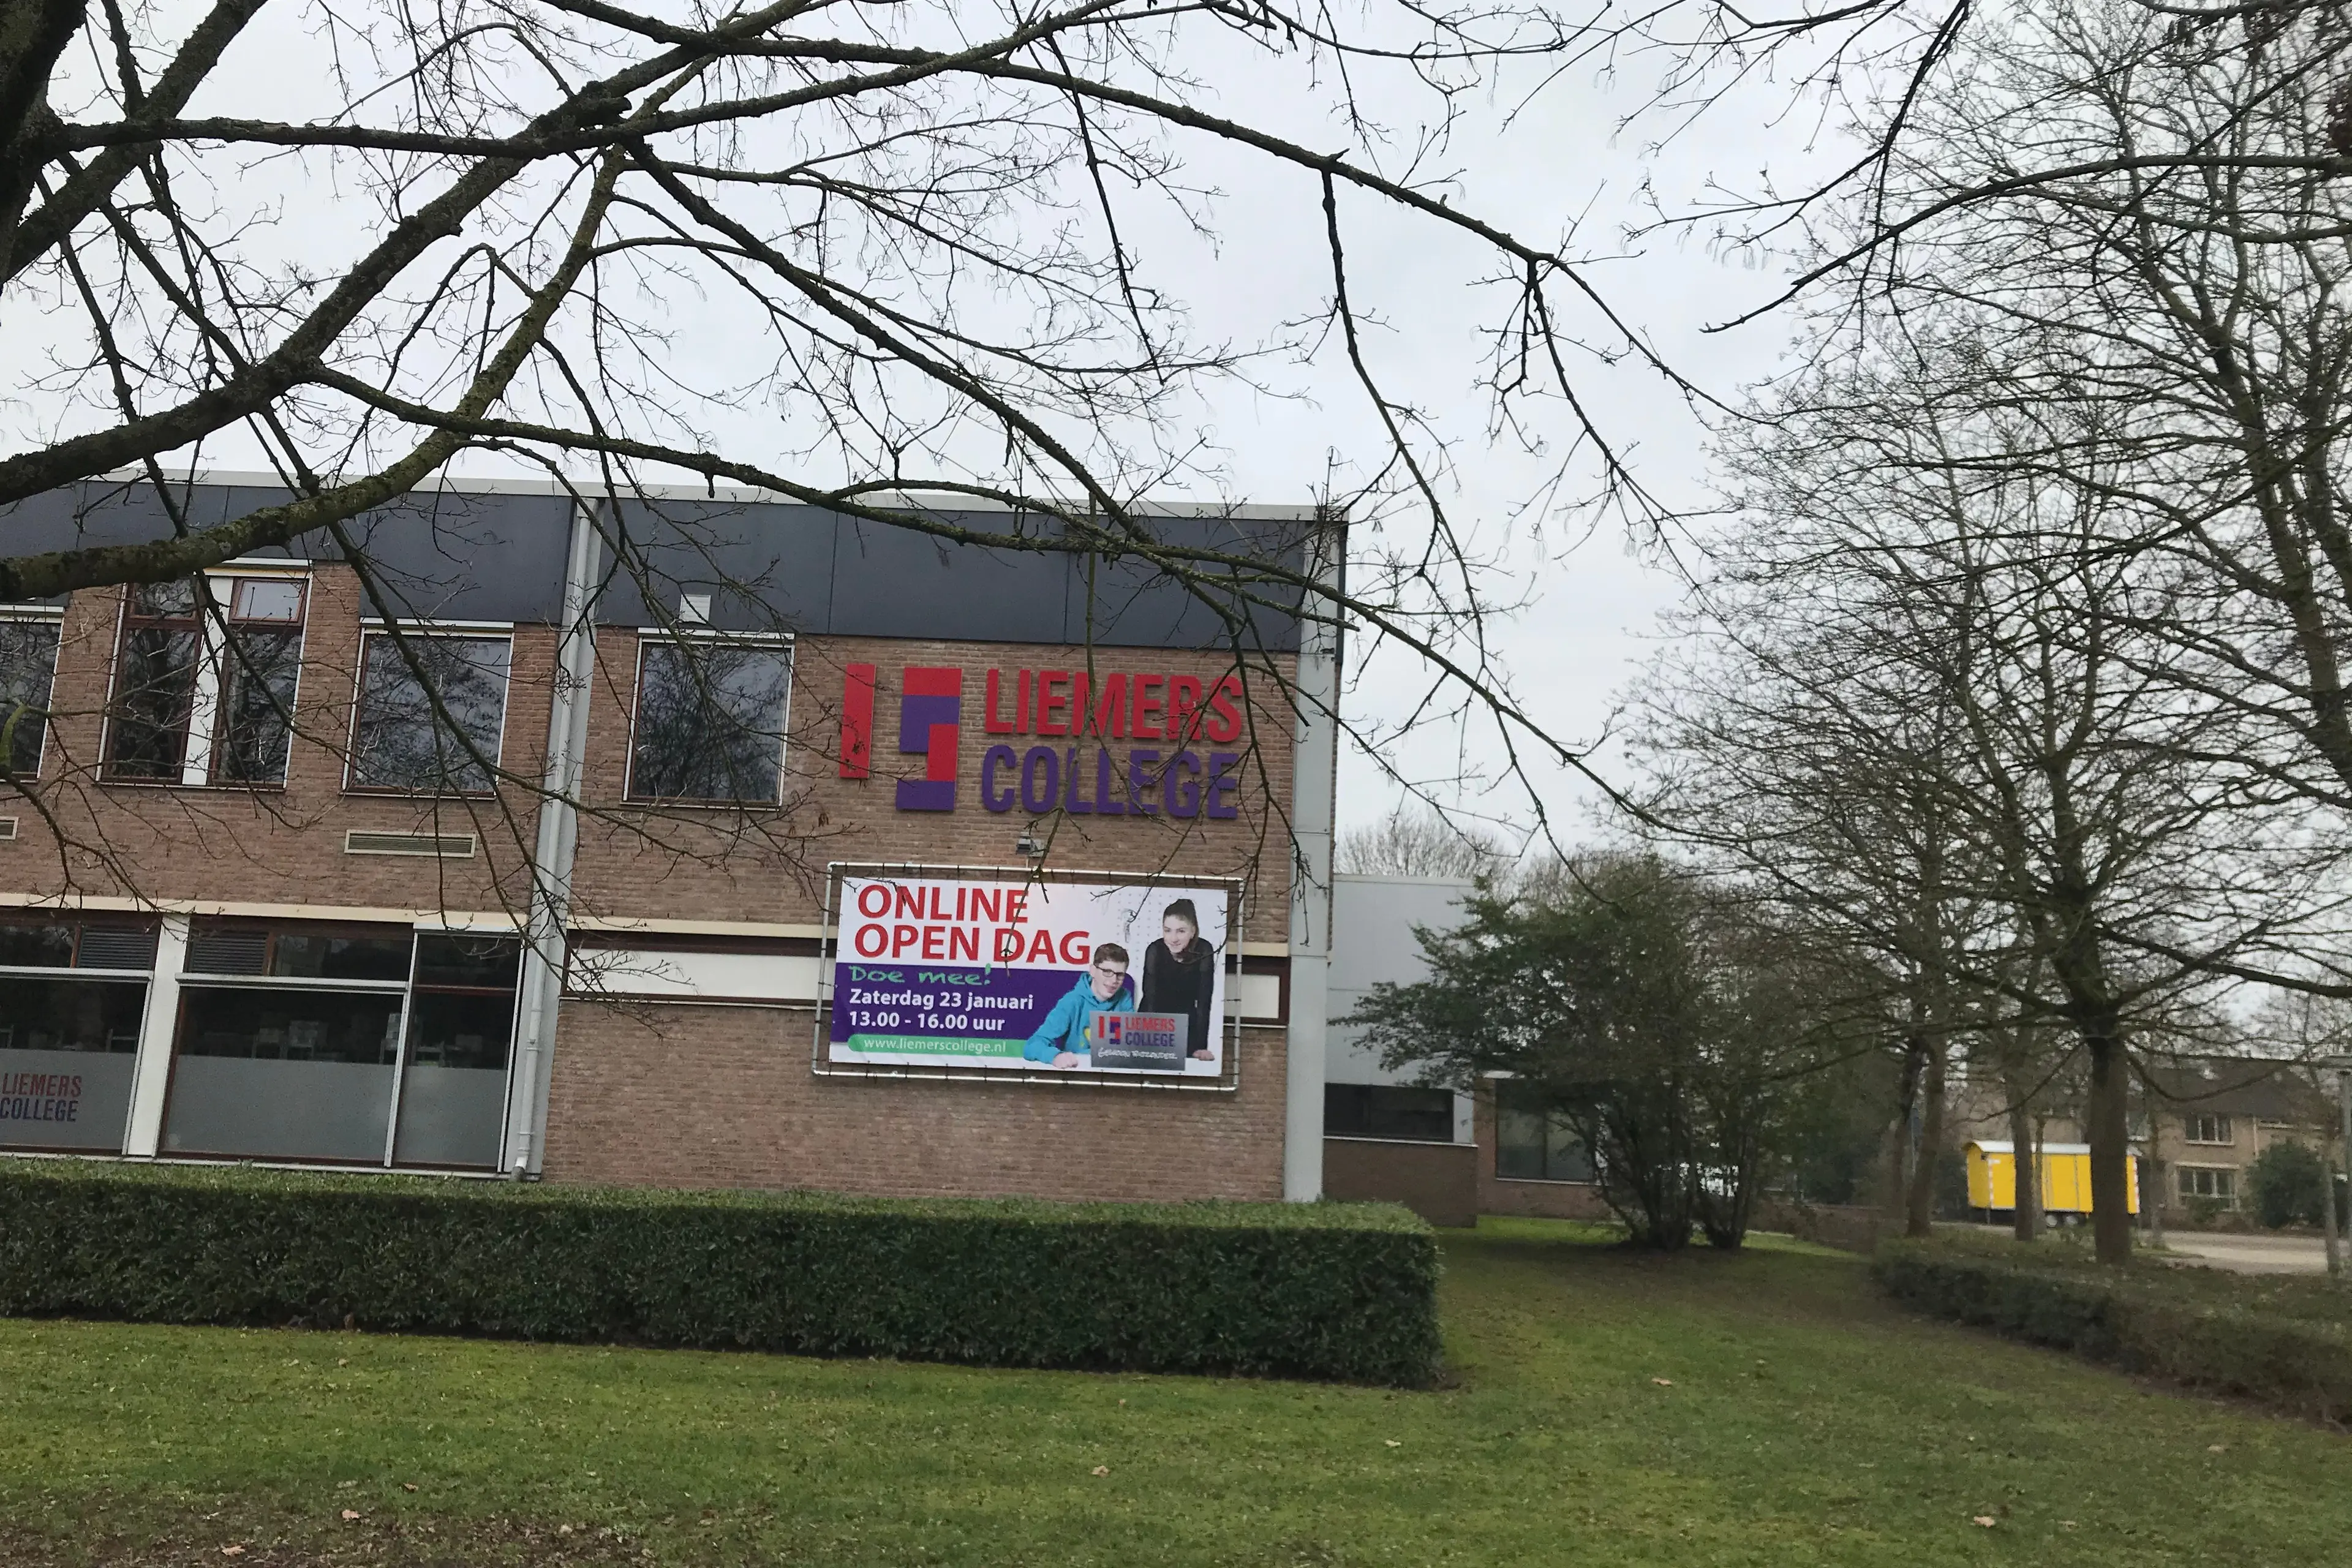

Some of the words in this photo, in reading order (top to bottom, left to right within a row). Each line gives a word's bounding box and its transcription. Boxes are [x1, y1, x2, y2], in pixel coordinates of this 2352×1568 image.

[984, 669, 1243, 742] LIEMERS
[982, 745, 1240, 820] COLLEGE
[858, 884, 1029, 923] ONLINE
[854, 923, 980, 961] OPEN
[993, 928, 1090, 965] DAG
[848, 965, 905, 983] Doe
[919, 963, 992, 985] mee!
[849, 988, 934, 1010] Zaterdag
[940, 992, 962, 1007] 23
[965, 992, 1034, 1011] januari
[849, 1011, 900, 1027] 13.00
[918, 1013, 968, 1030] 16.00
[973, 1017, 1005, 1031] uur
[1125, 1017, 1175, 1032] LIEMERS
[864, 1039, 1006, 1054] www.liemerscollege.nl
[1125, 1032, 1175, 1047] COLLEGE
[2, 1072, 83, 1098] LIEMERS
[0, 1097, 79, 1123] COLLEGE
